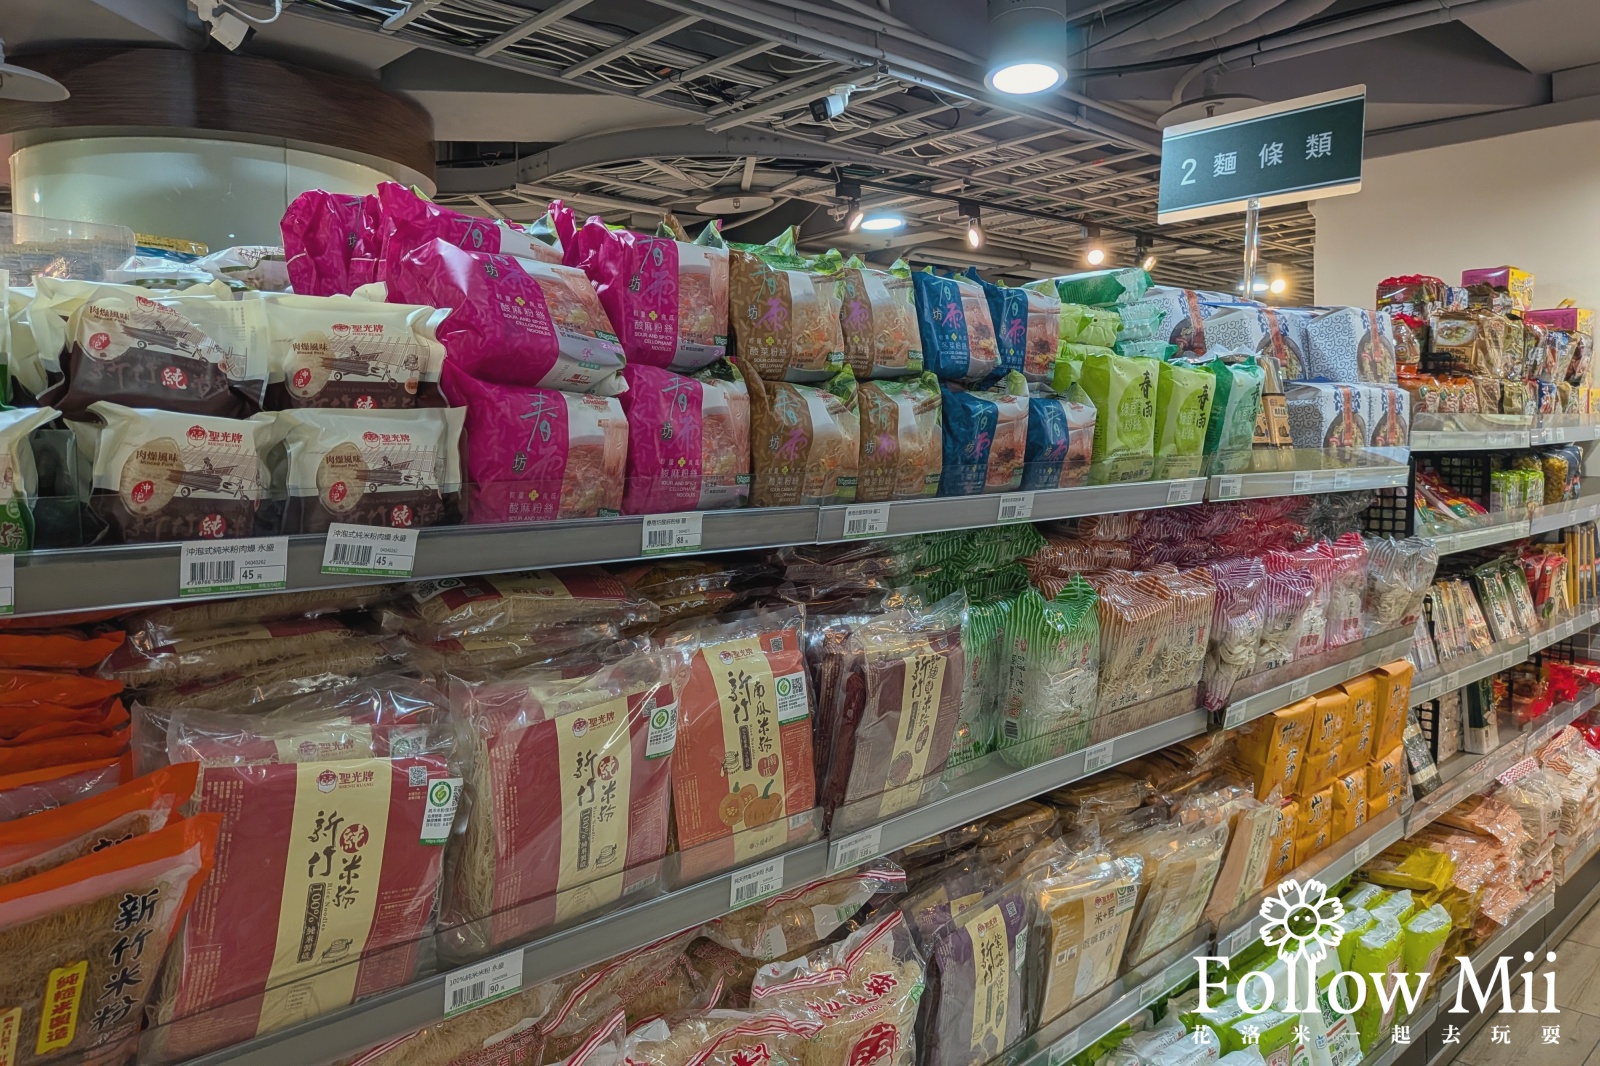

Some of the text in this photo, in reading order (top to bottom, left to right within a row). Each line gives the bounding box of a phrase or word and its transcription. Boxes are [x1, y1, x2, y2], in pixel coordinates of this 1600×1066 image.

[1180, 131, 1334, 187] 2 麵條類
[350, 323, 384, 333] 聖光牌
[207, 430, 243, 444] 聖光牌
[381, 433, 411, 443] 聖光牌
[135, 450, 179, 463] 肉燥風味
[391, 504, 412, 527] 純
[376, 555, 387, 566] 45
[242, 569, 254, 580] 45
[338, 770, 375, 785] 聖光牌
[307, 809, 345, 879] 新竹
[307, 886, 324, 924] 100%
[82, 887, 160, 1036] 新竹米粉
[490, 983, 500, 994] 90
